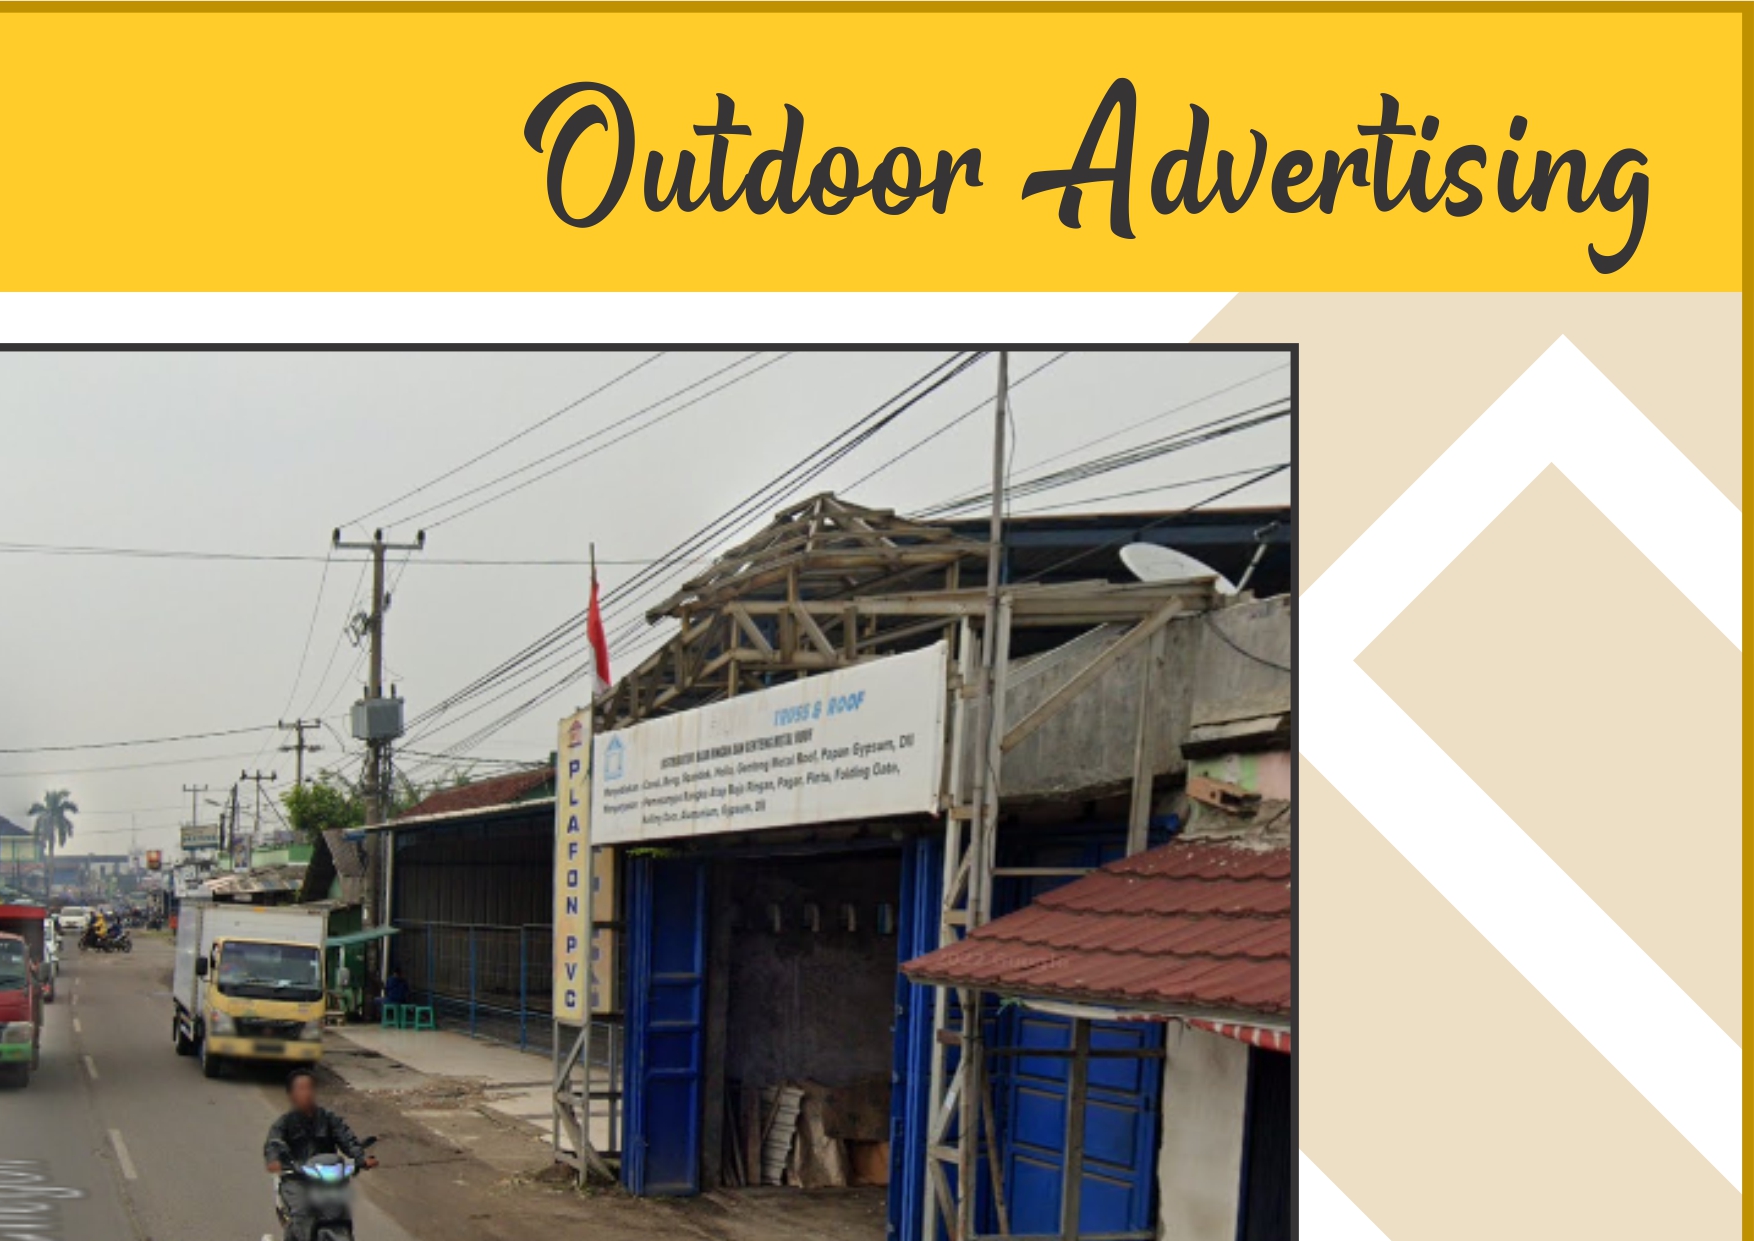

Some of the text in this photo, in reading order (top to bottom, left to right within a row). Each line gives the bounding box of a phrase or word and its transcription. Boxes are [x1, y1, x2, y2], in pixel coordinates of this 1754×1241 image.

[524, 78, 1648, 274] Outdoor Advertising
[826, 690, 866, 716] ROOF
[564, 759, 581, 1009] PLAFON PVC
